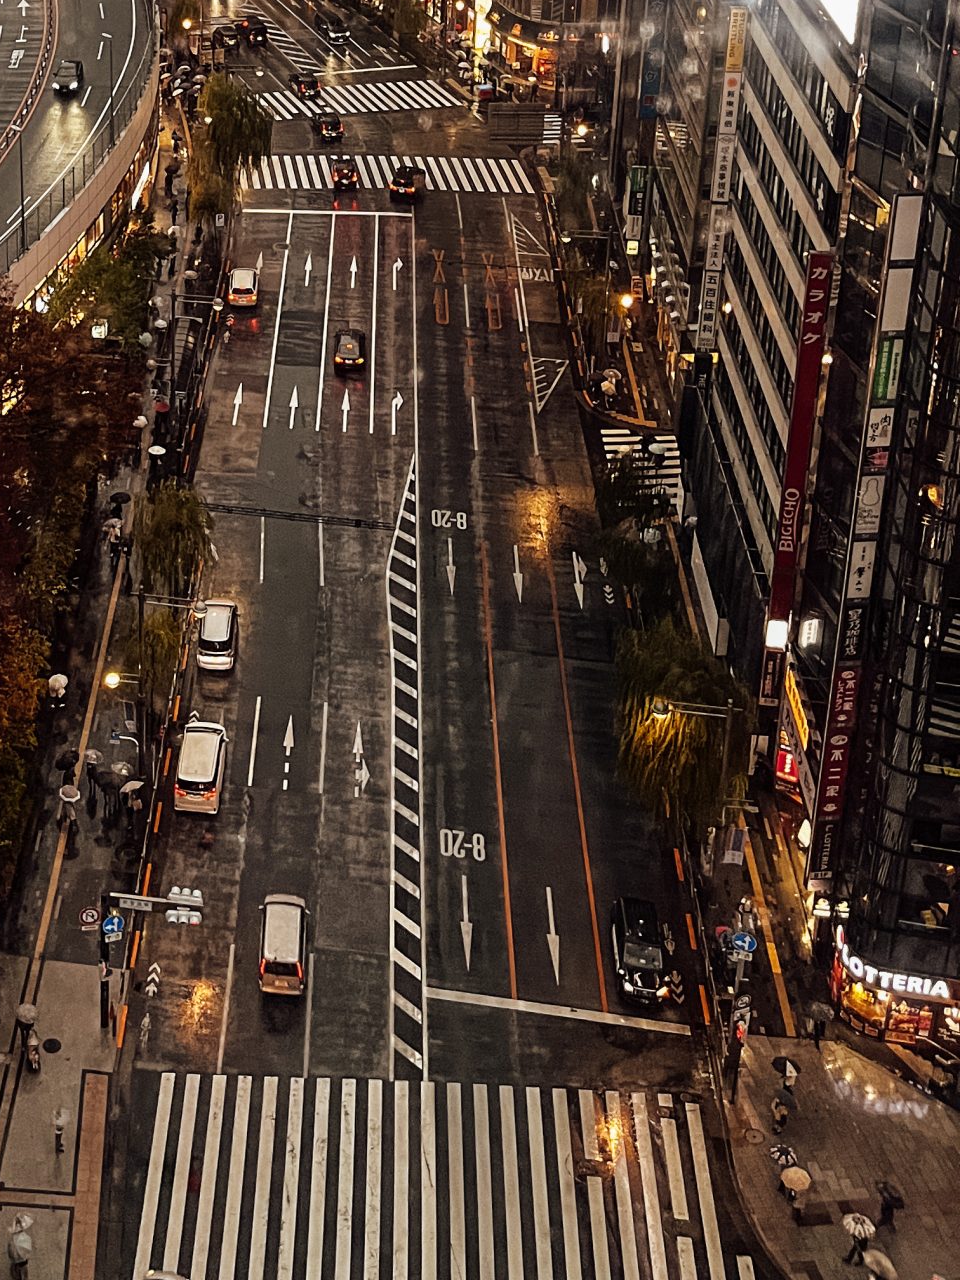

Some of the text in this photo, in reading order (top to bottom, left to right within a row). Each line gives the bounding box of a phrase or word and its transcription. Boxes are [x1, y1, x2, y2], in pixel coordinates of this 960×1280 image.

[802, 267, 828, 345] カラオケ
[843, 608, 864, 656] 星乃珈琲店
[825, 749, 845, 797] 不二家
[842, 942, 950, 999] LOTTERIA
